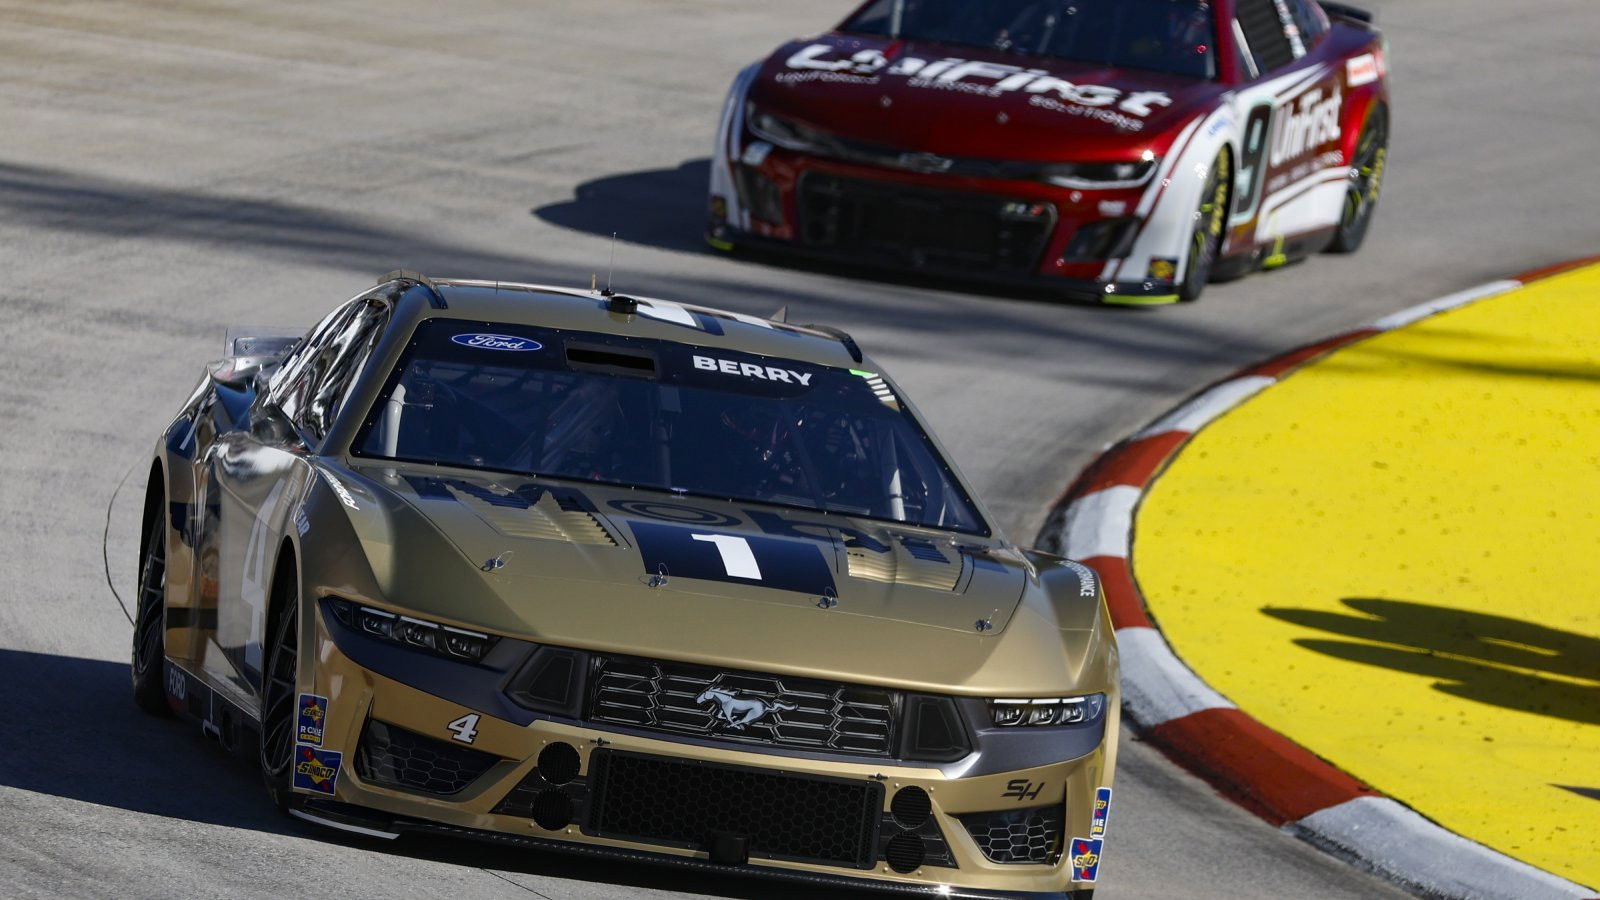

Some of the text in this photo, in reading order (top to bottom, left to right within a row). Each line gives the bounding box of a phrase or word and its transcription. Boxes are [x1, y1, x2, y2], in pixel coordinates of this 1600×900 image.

[785, 43, 1173, 118] UniFirst
[1229, 101, 1276, 226] 9
[466, 334, 526, 351] Ford
[692, 354, 813, 388] BERRY
[690, 533, 762, 581] 1
[447, 712, 481, 744] 4
